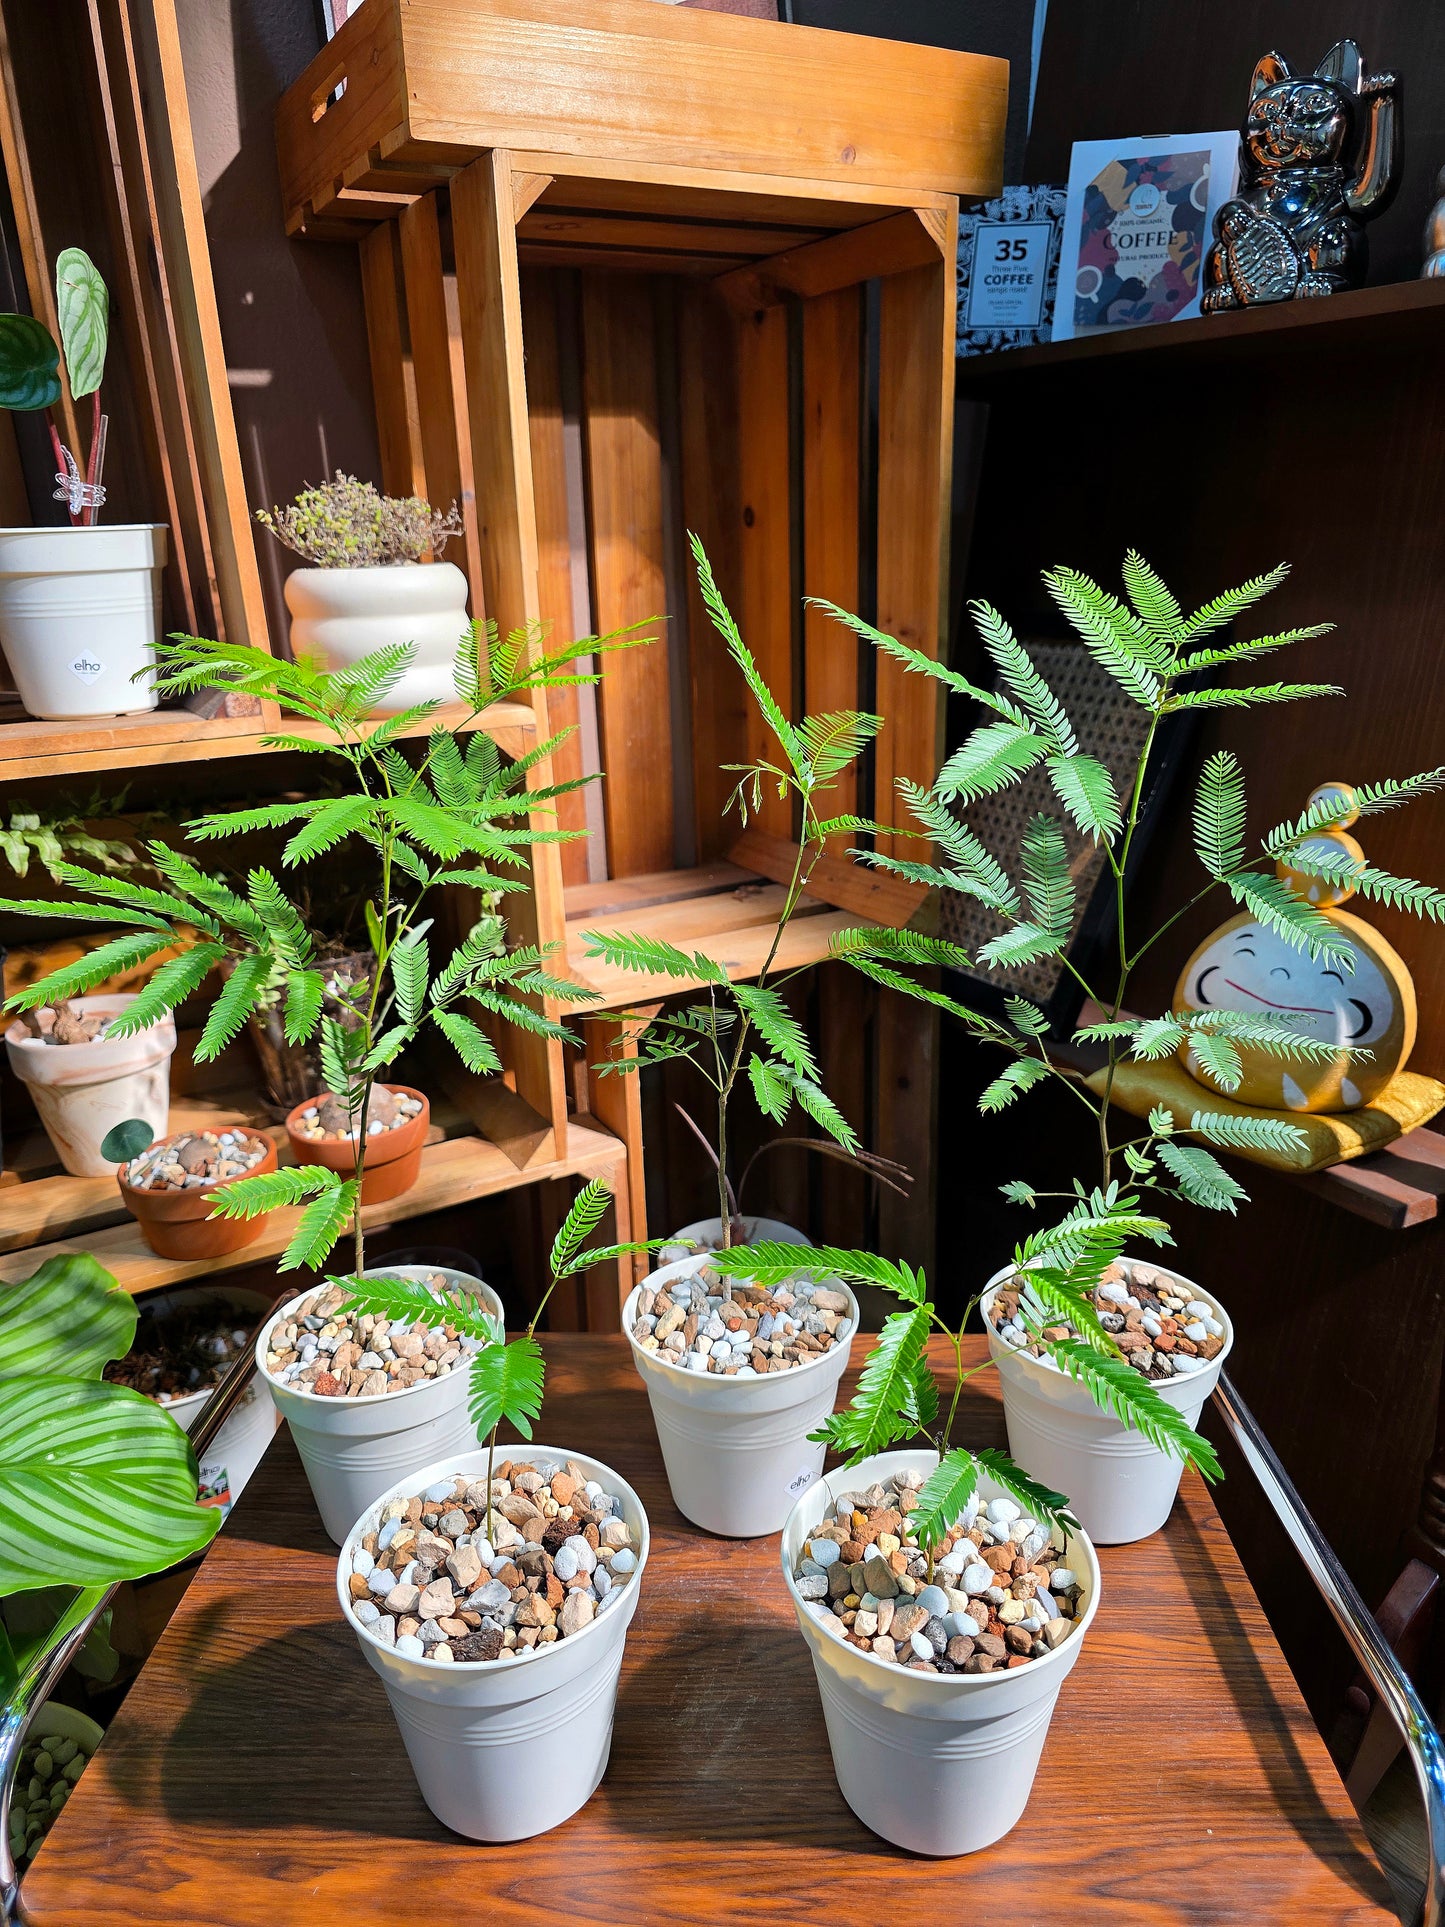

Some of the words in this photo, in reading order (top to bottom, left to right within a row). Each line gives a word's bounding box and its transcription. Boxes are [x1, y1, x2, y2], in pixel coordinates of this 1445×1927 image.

[1103, 230, 1179, 251] COFFEE
[995, 239, 1028, 261] 35
[1139, 252, 1169, 260] PRODUCT
[983, 273, 1035, 286] COFFEE
[74, 659, 101, 671] elho
[790, 1473, 811, 1490] elho
